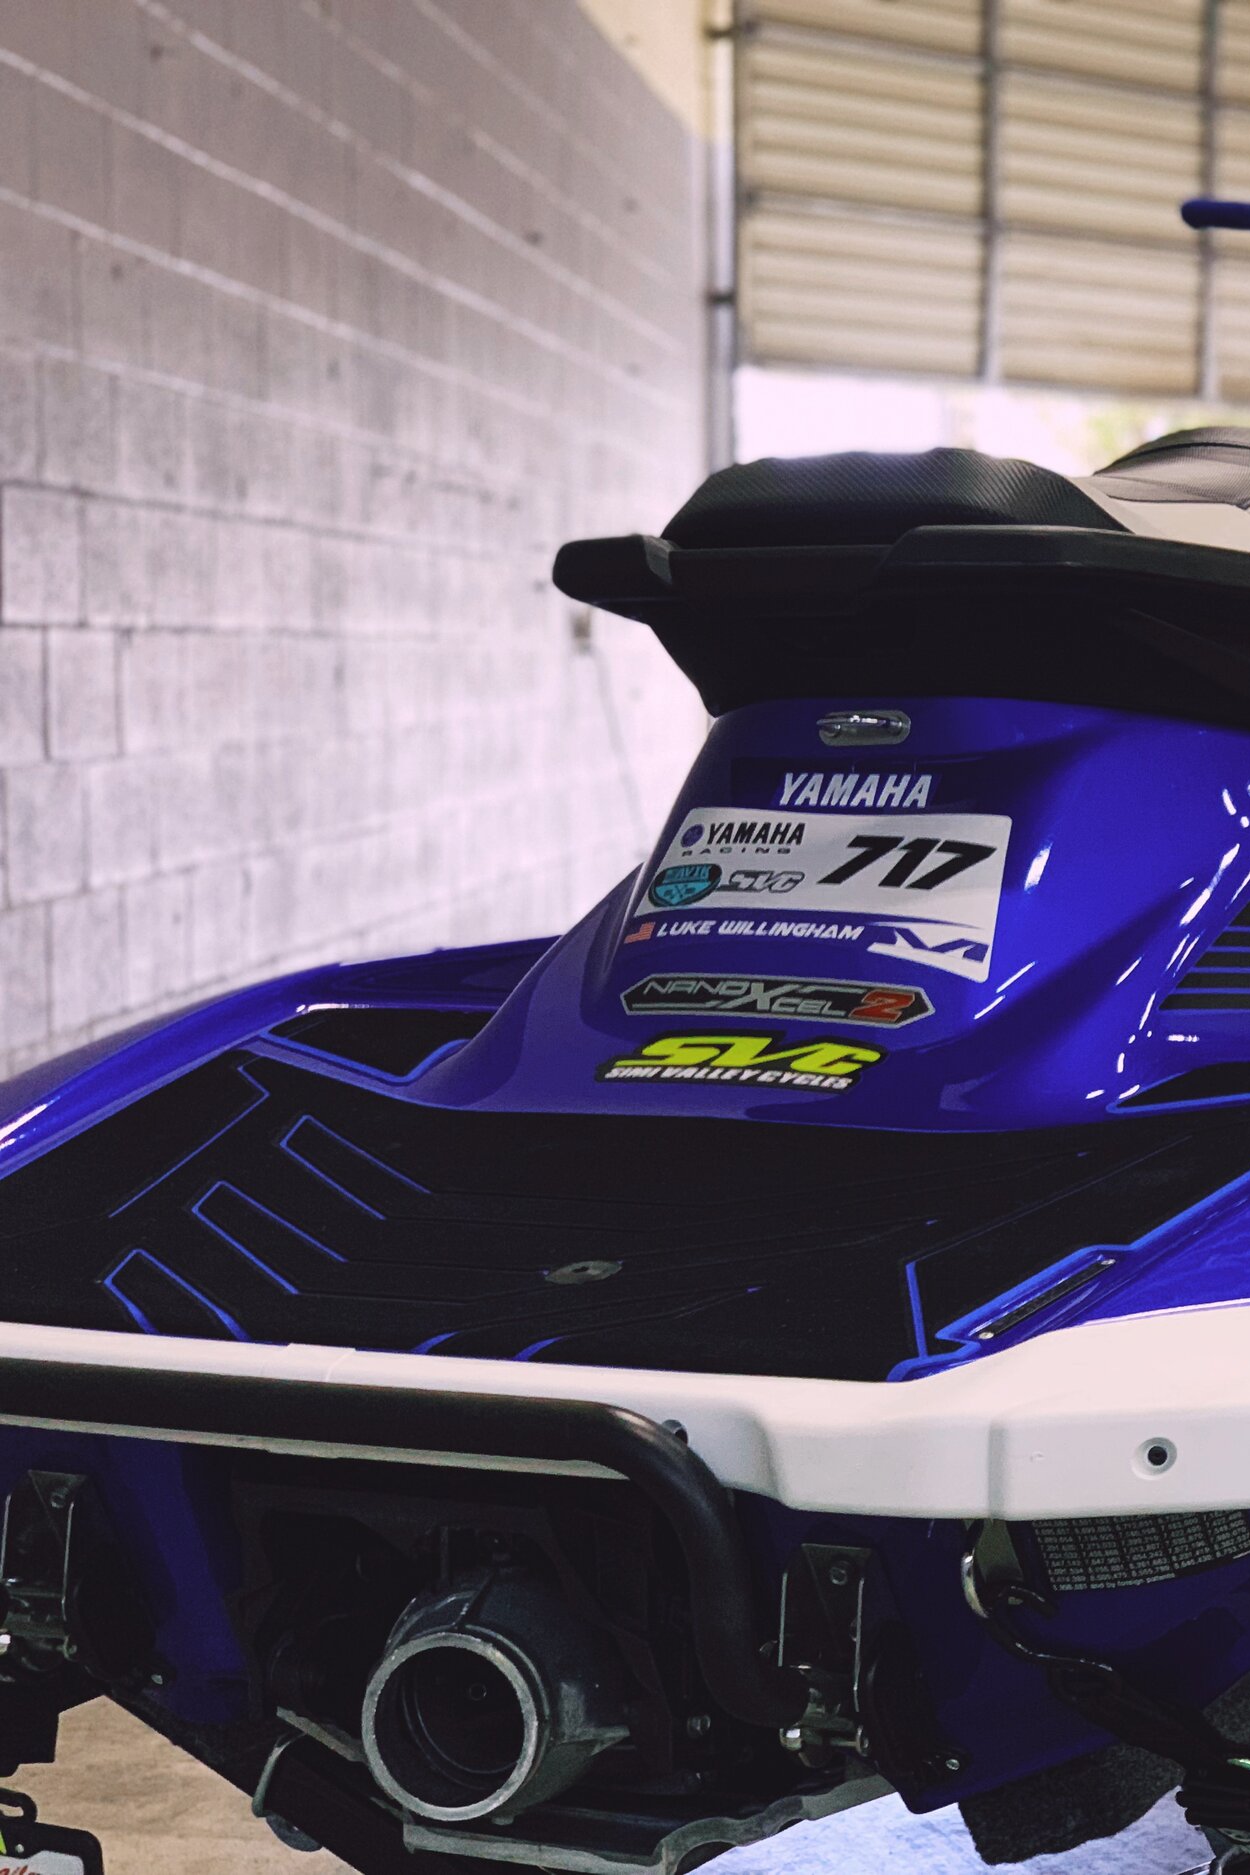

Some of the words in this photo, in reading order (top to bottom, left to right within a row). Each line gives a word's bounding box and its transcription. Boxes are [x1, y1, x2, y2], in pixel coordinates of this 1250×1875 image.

[779, 773, 933, 808] YAMAHA
[706, 821, 807, 846] YAMAHA
[681, 846, 791, 857] RACING
[815, 835, 998, 891] 717
[715, 869, 806, 893] SVC
[656, 920, 717, 938] LUKE
[718, 920, 865, 941] WILLINGHAM
[849, 988, 916, 1022] 2
[614, 1036, 882, 1075] SVC
[605, 1066, 661, 1079] SIMI
[660, 1067, 758, 1081] VALLEY
[757, 1070, 852, 1090] CYCLES
